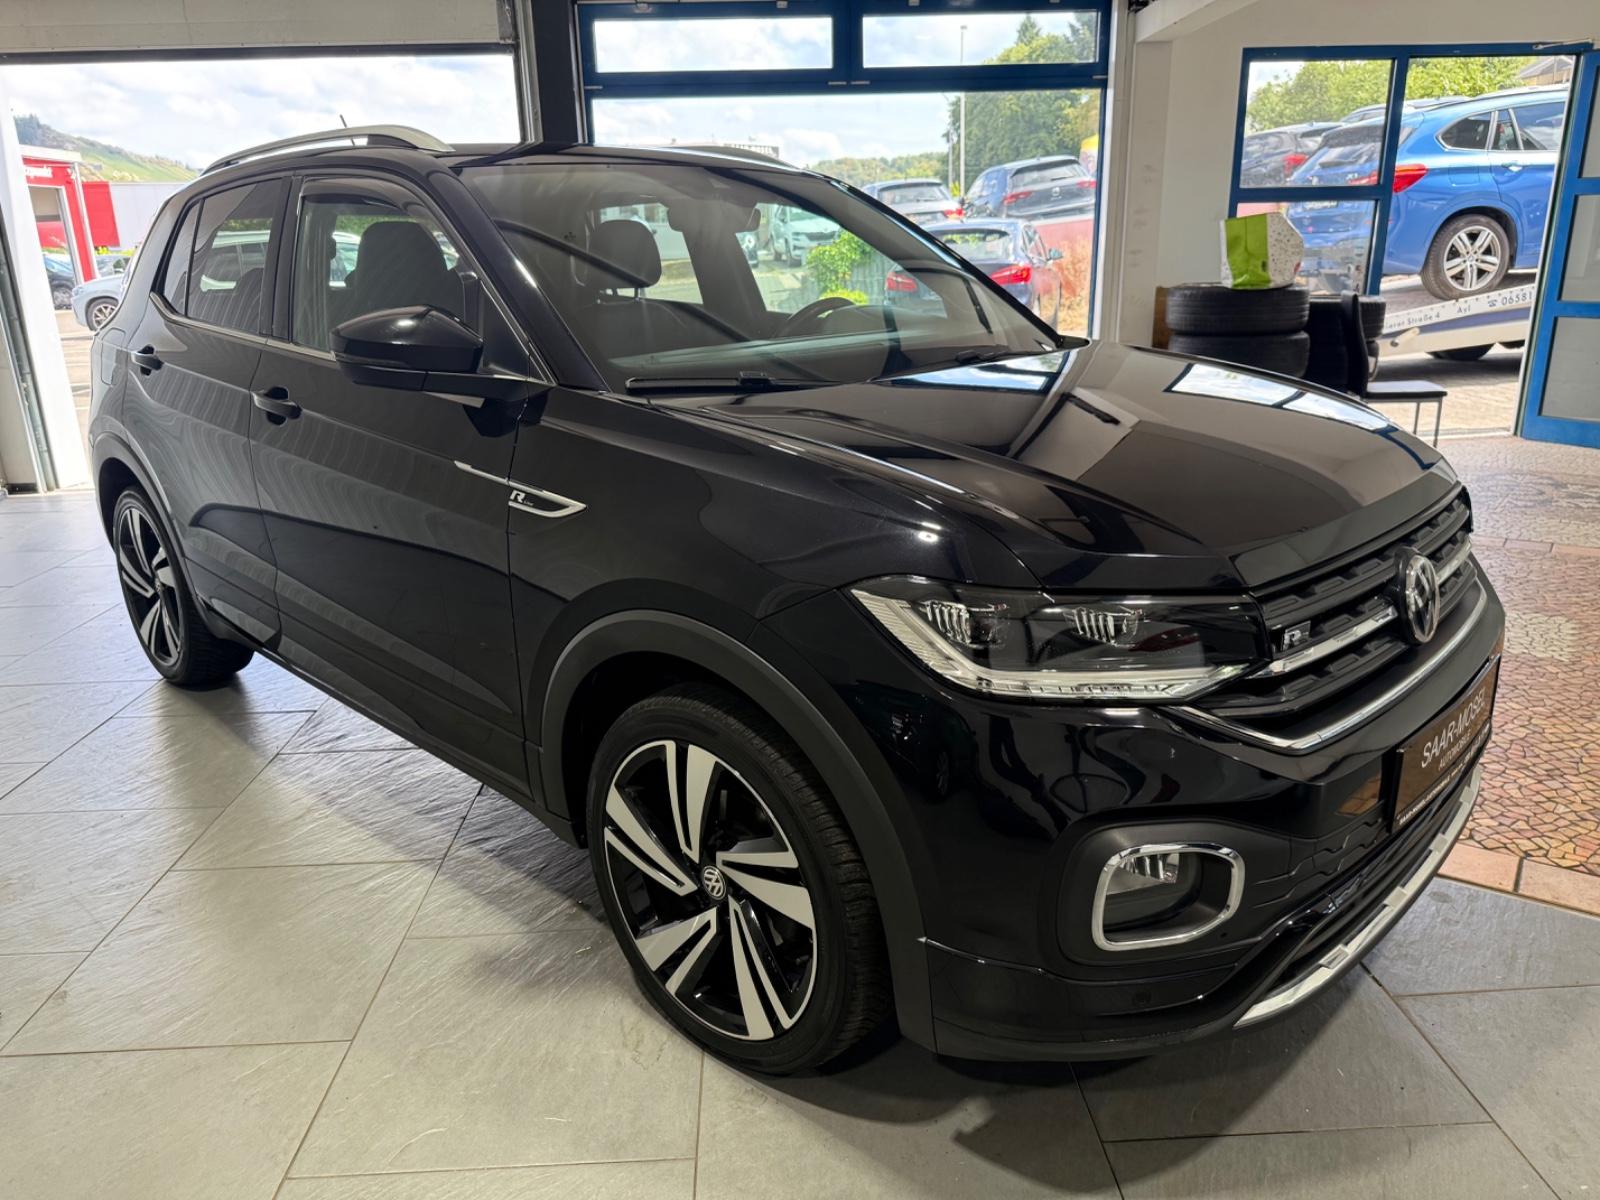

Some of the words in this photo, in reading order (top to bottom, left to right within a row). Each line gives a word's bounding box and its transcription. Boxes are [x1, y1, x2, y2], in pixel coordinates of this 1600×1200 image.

[1501, 291, 1532, 306] 06581
[510, 490, 526, 503] R
[1421, 687, 1486, 768] SAAR-MOSEL
